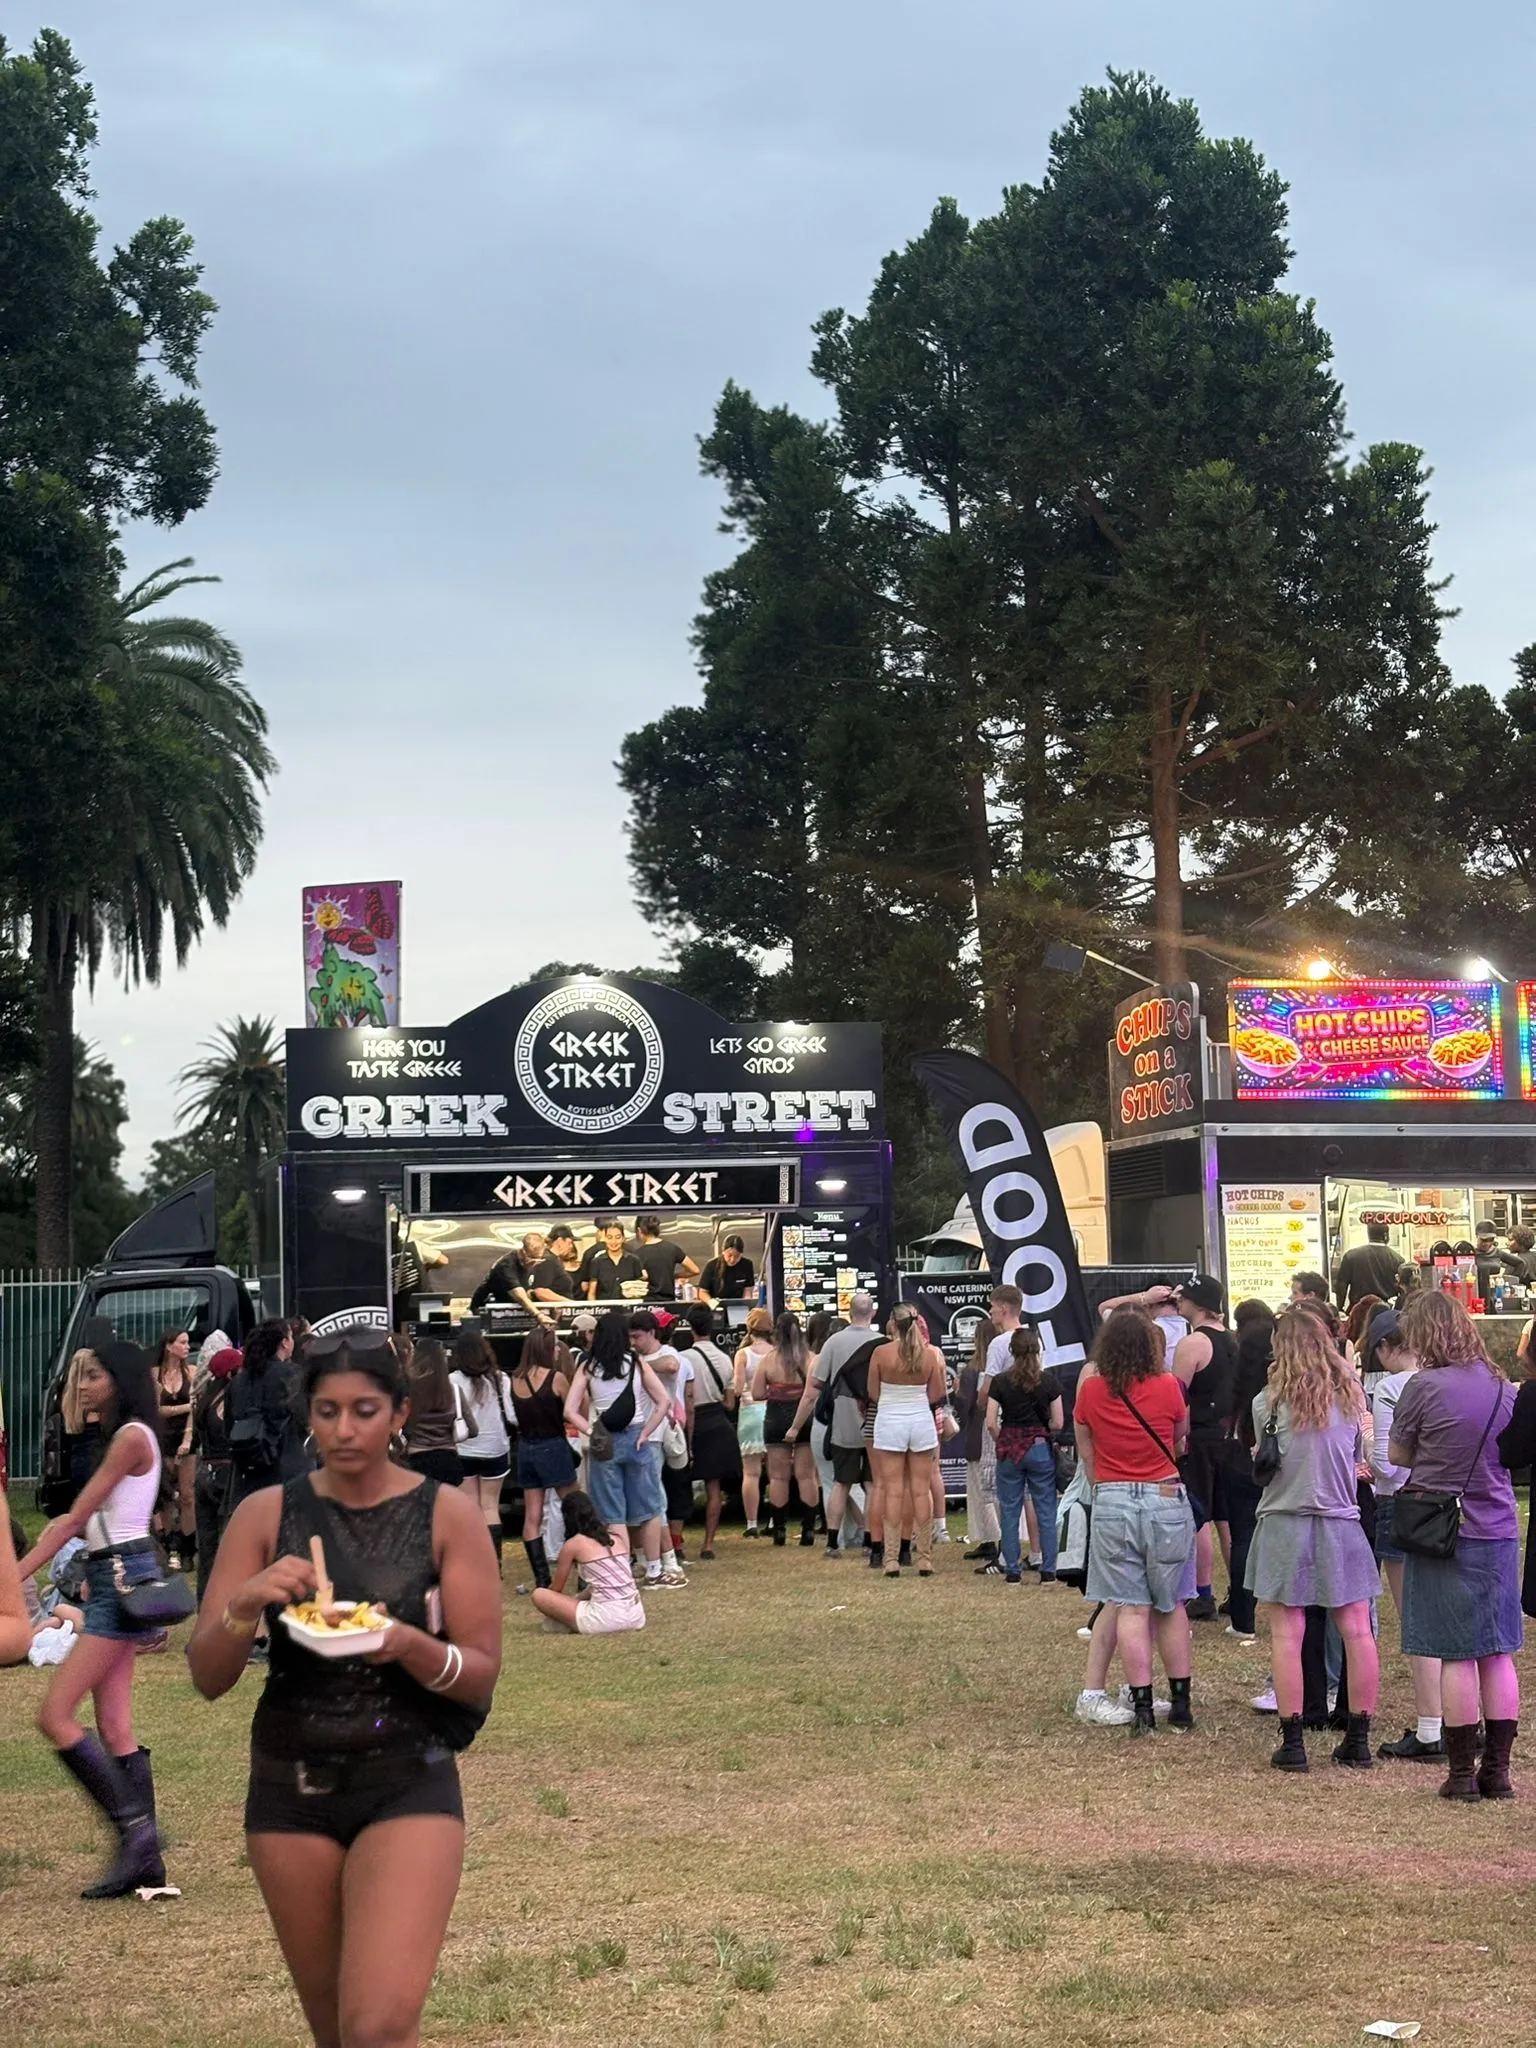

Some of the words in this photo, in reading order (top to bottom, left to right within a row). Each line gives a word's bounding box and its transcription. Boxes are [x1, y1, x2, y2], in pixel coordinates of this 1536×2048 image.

[544, 1002, 589, 1030] AUTHENTIC
[594, 1003, 634, 1030] CHARCOAL
[1116, 998, 1192, 1056] CHIPS
[1295, 1012, 1348, 1038] HOT
[1353, 1008, 1429, 1034] CHIPS
[362, 1039, 405, 1058] HERE
[407, 1039, 446, 1057] YOU
[549, 1031, 630, 1058] GREEK
[710, 1037, 743, 1054] LETS
[746, 1037, 774, 1053] GO
[777, 1036, 827, 1053] GREEK
[1303, 1041, 1318, 1058] &
[1320, 1037, 1380, 1056] CHEESE
[1381, 1034, 1430, 1052] SAUCE
[347, 1060, 399, 1078] TASTE
[402, 1060, 462, 1077] GREECE
[743, 1056, 796, 1074] GYROS
[1134, 1049, 1160, 1077] on
[1164, 1046, 1176, 1070] a
[544, 1062, 636, 1089] STREET
[567, 1104, 615, 1115] ROTISSERIE
[1121, 1073, 1194, 1124] STICK
[301, 1094, 509, 1139] GREEK
[663, 1090, 876, 1134] STREET
[493, 1174, 595, 1208] GREEK
[605, 1171, 719, 1206] STREET
[1225, 1189, 1249, 1202] HOT
[1250, 1189, 1285, 1202] CHIPS
[1411, 1212, 1443, 1224] ONLY
[958, 1102, 1087, 1372] FOOD
[917, 1285, 925, 1294] A
[926, 1285, 948, 1294] ONE
[949, 1283, 993, 1293] CATERING
[1248, 1279, 1274, 1287] CHIPS
[944, 1295, 966, 1304] NSW
[967, 1295, 985, 1303] PTY
